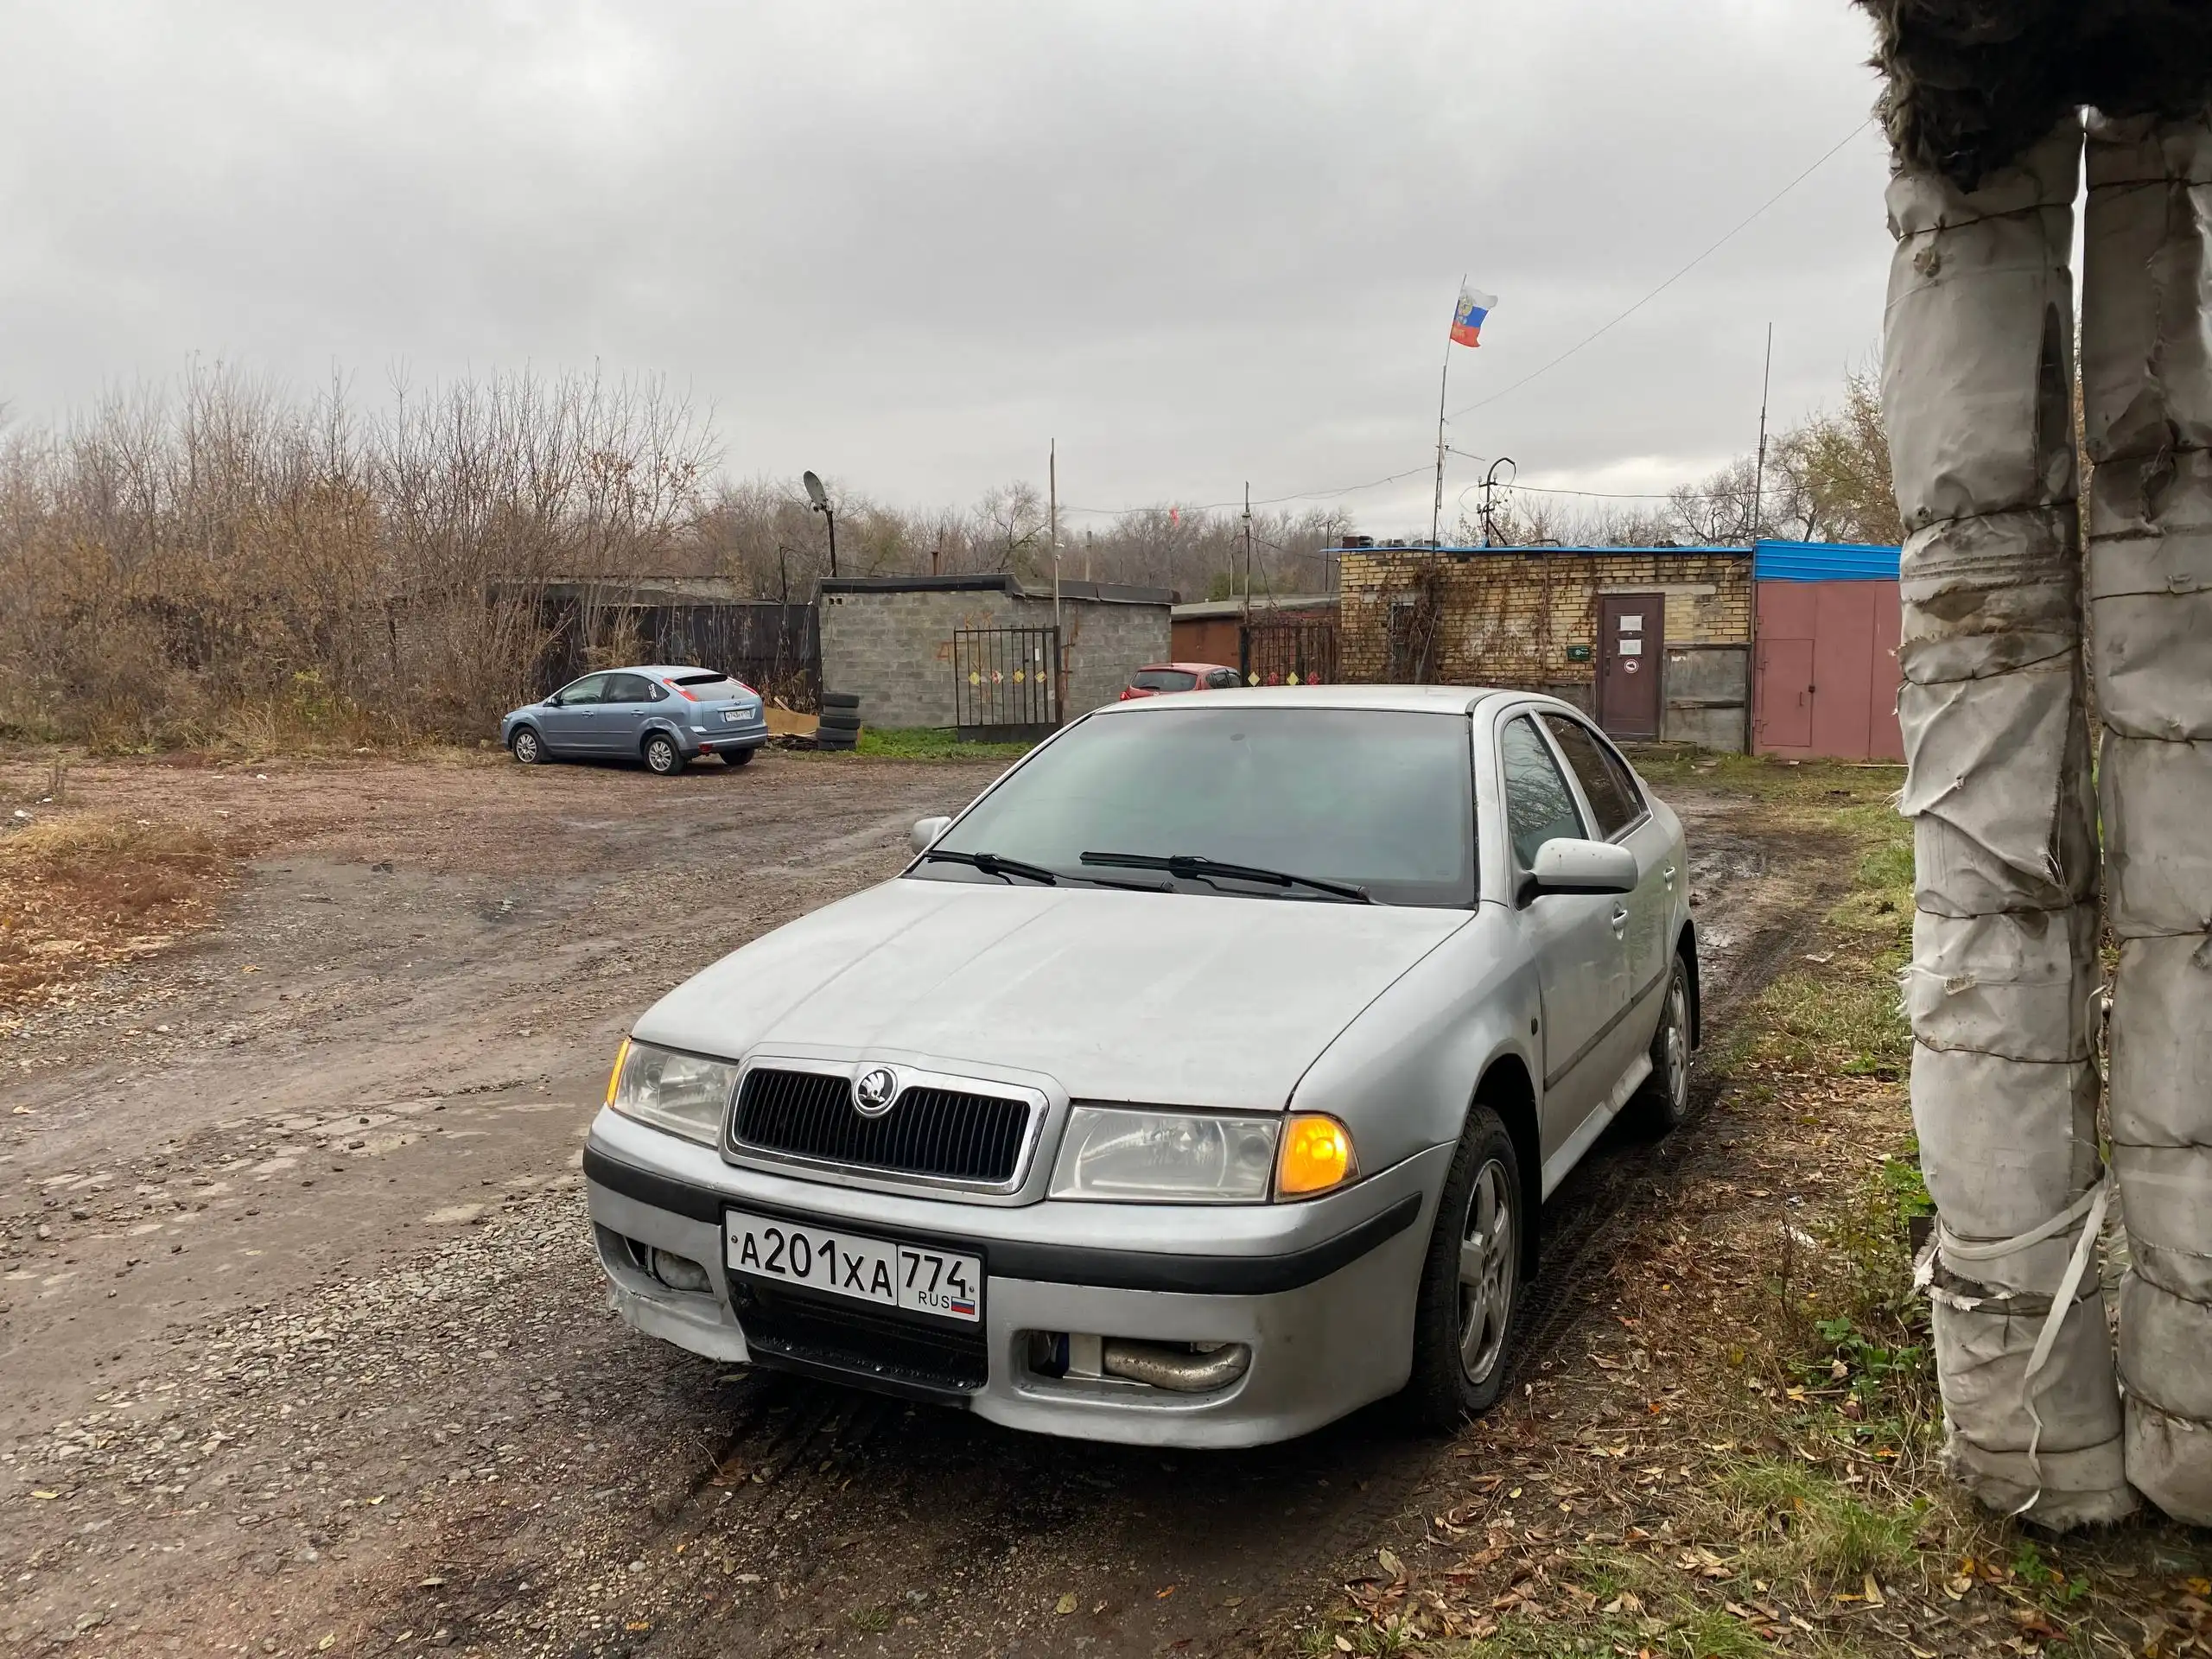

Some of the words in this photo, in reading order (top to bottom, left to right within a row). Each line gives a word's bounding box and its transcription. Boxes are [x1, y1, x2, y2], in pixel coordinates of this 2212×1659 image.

[741, 1227, 893, 1298] А201ХА
[901, 1250, 966, 1298] 774
[918, 1291, 950, 1309] RUS
